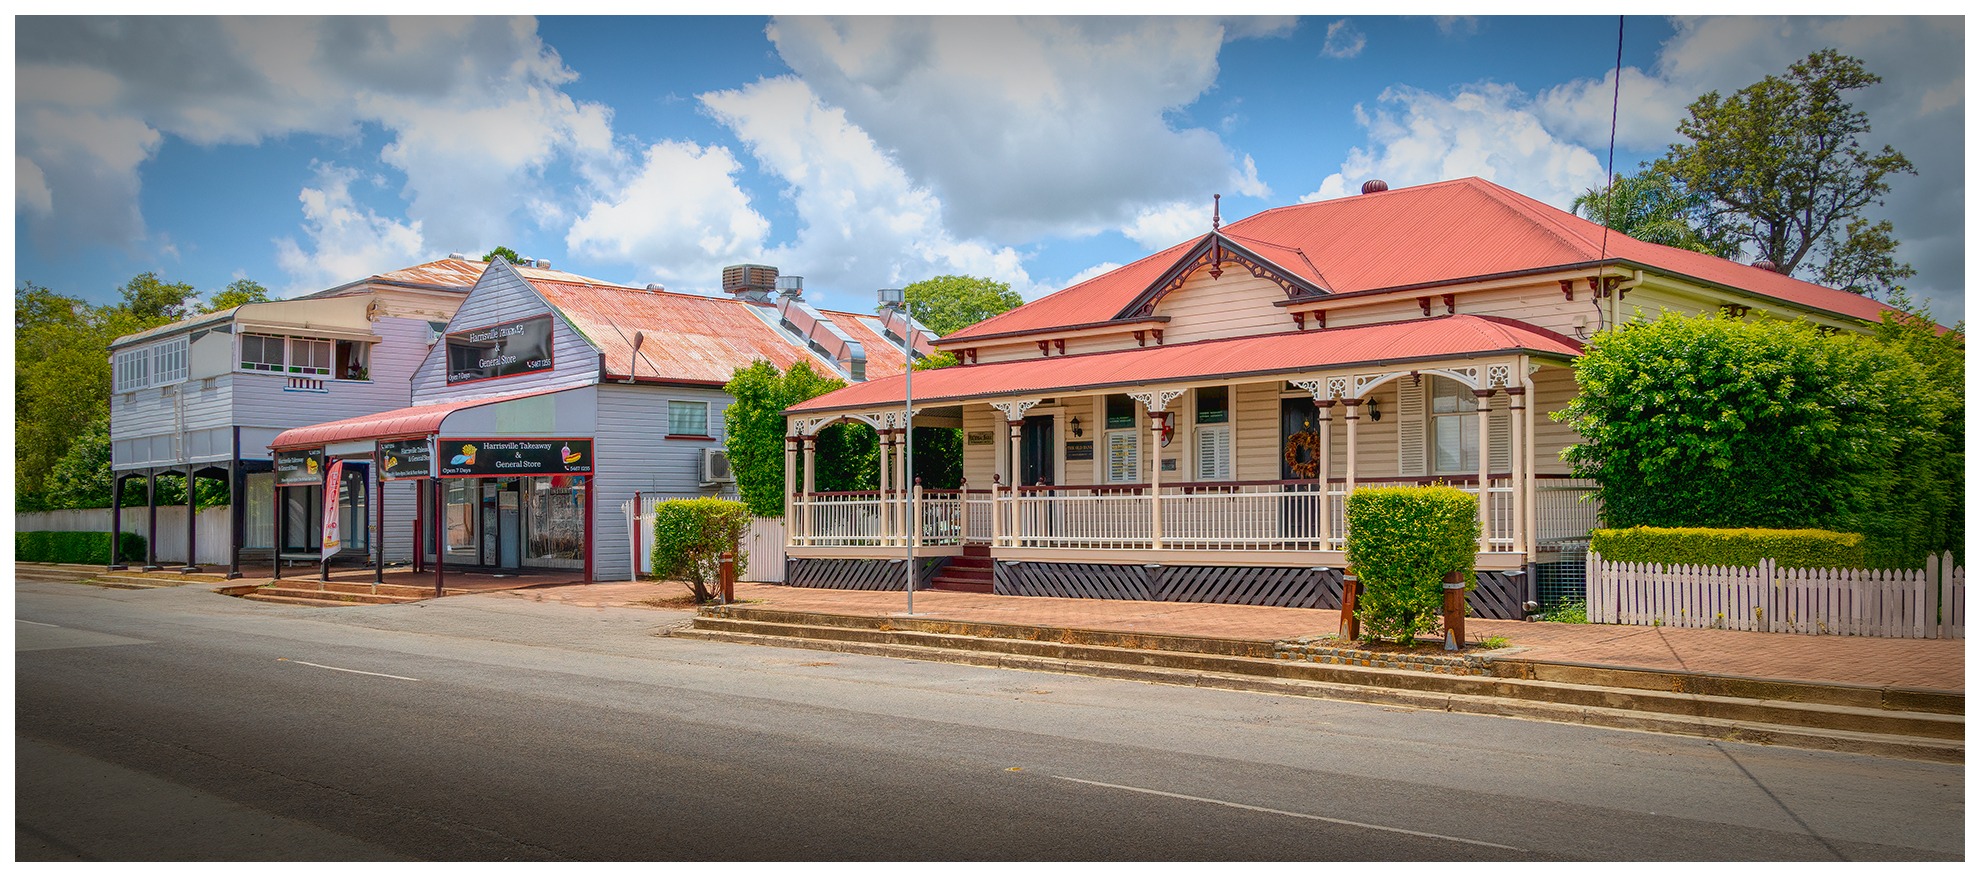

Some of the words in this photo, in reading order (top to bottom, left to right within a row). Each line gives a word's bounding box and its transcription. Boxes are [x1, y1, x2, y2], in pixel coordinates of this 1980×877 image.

[469, 329, 498, 343] Harrisville
[494, 342, 500, 352] &
[478, 357, 500, 368] General
[501, 354, 517, 365] Store
[448, 374, 457, 382] Open
[461, 372, 471, 380] Days
[483, 442, 519, 450] Harrisville
[519, 442, 552, 451] Takeaway
[514, 451, 522, 459] &
[495, 460, 522, 468] General
[523, 460, 541, 468] Store
